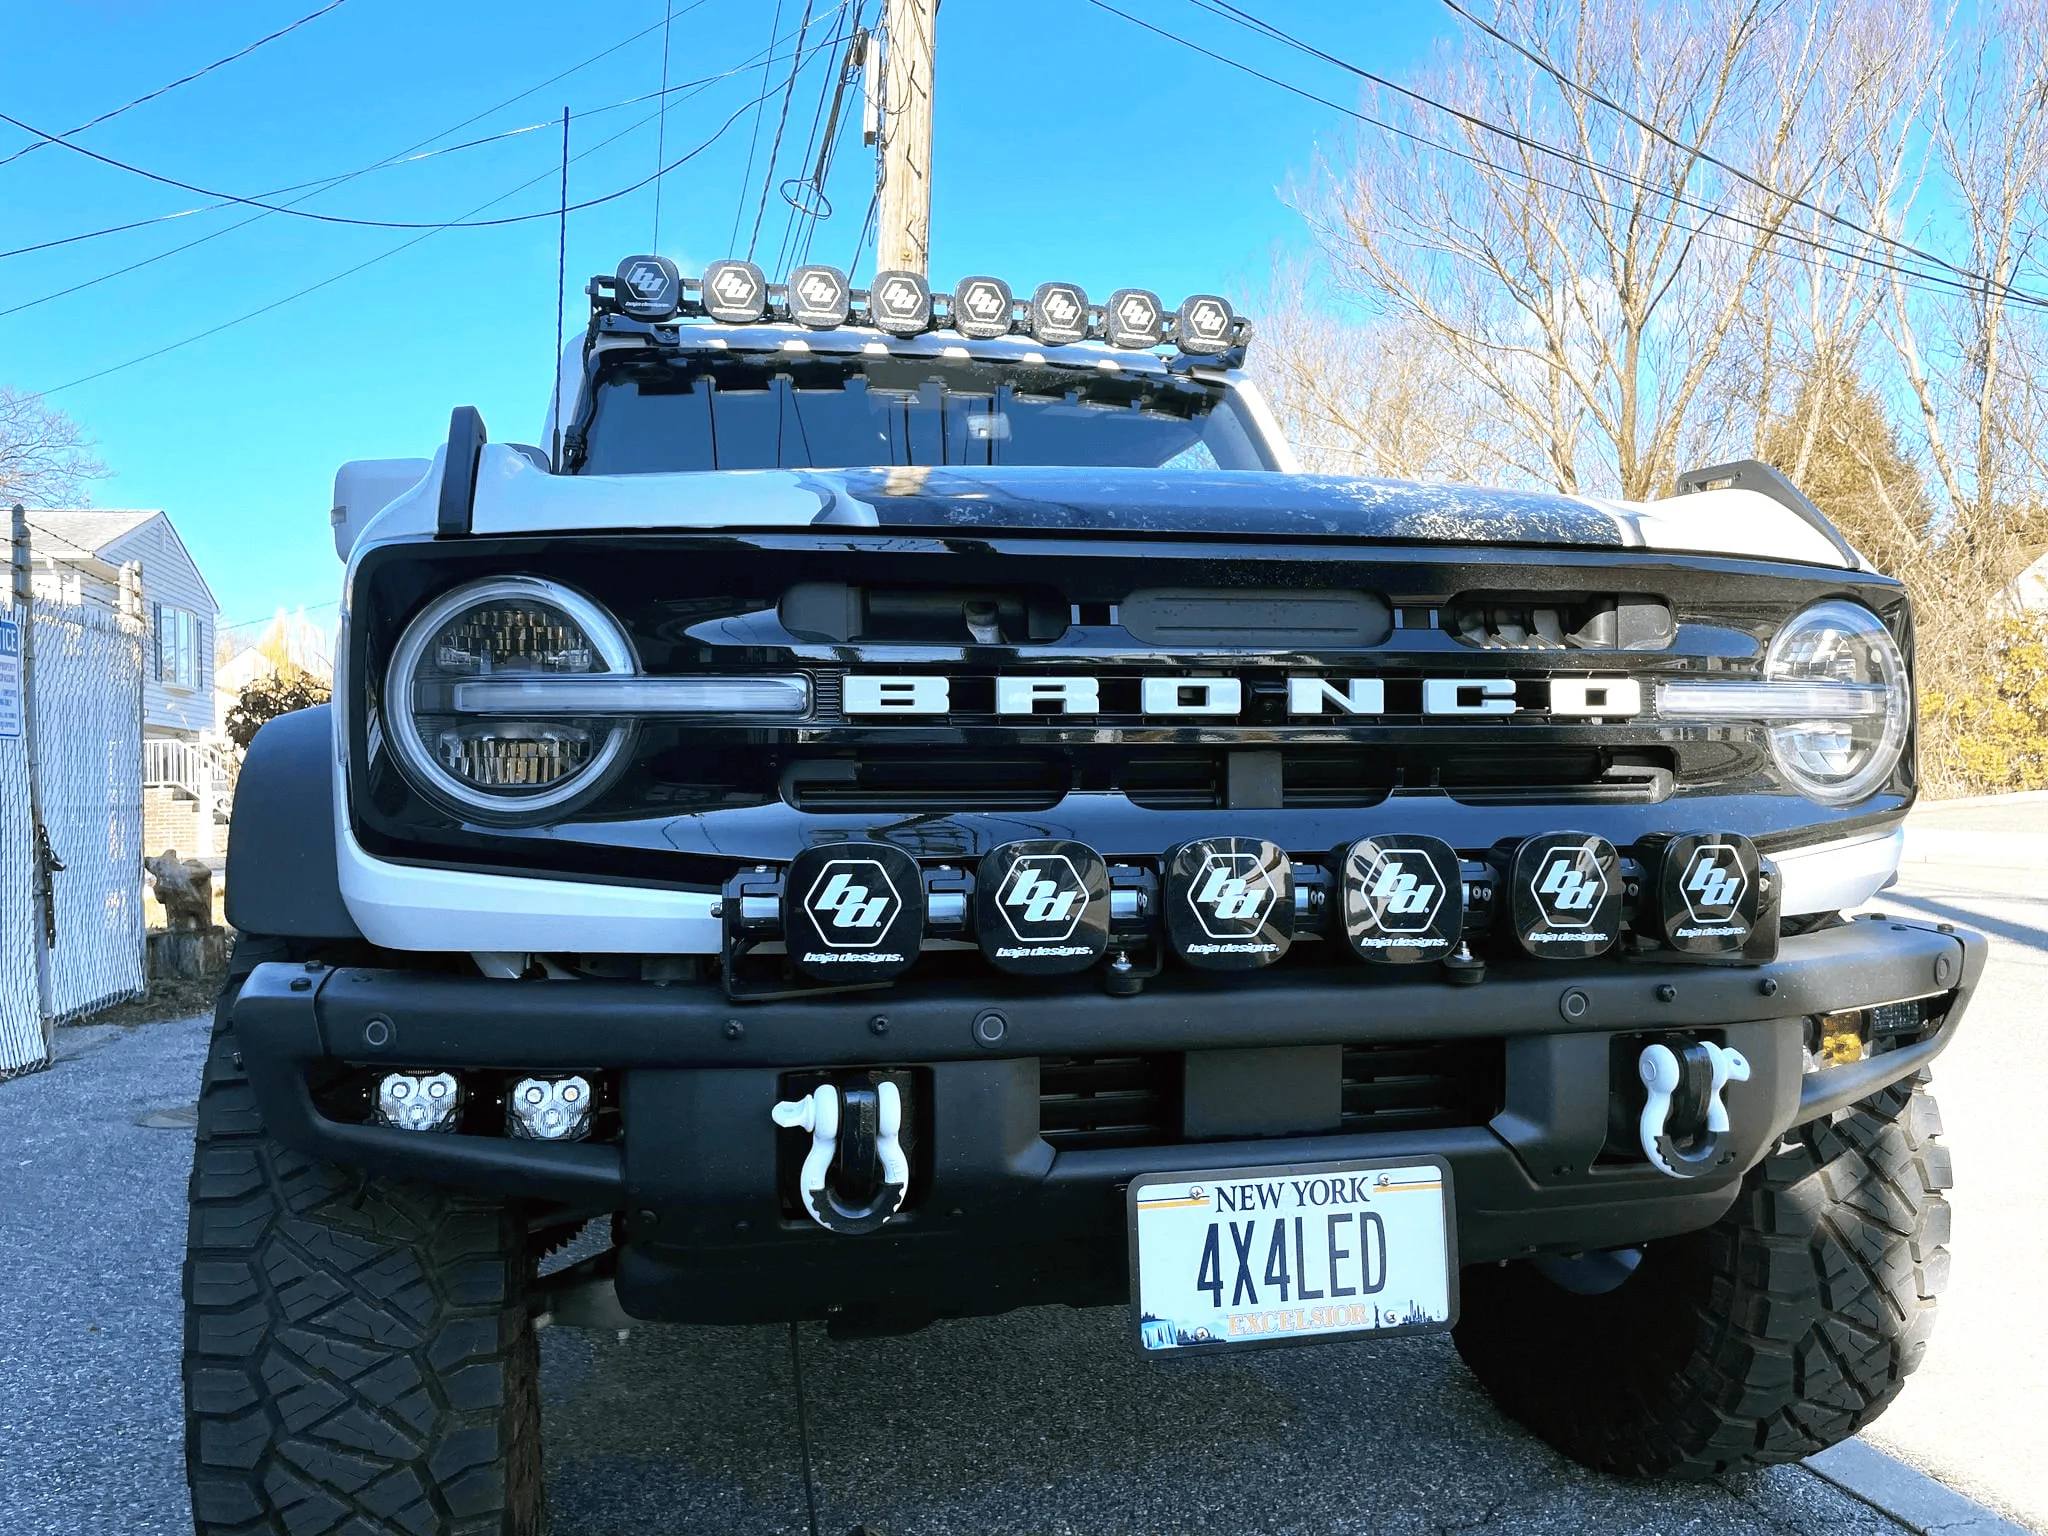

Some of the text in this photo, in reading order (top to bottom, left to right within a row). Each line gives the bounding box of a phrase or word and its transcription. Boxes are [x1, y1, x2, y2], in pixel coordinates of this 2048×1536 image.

[842, 676, 1640, 717] BRONCO
[1528, 932, 1558, 943] baja
[1676, 927, 1702, 938] baja
[1361, 937, 1392, 948] baja
[996, 947, 1030, 958] baja
[1187, 943, 1220, 954] baja
[803, 952, 839, 964] baja
[1215, 1176, 1370, 1213] NEW YORK
[1197, 1211, 1387, 1308] 4X4LED
[1226, 1303, 1369, 1337] EXCELSIOR
